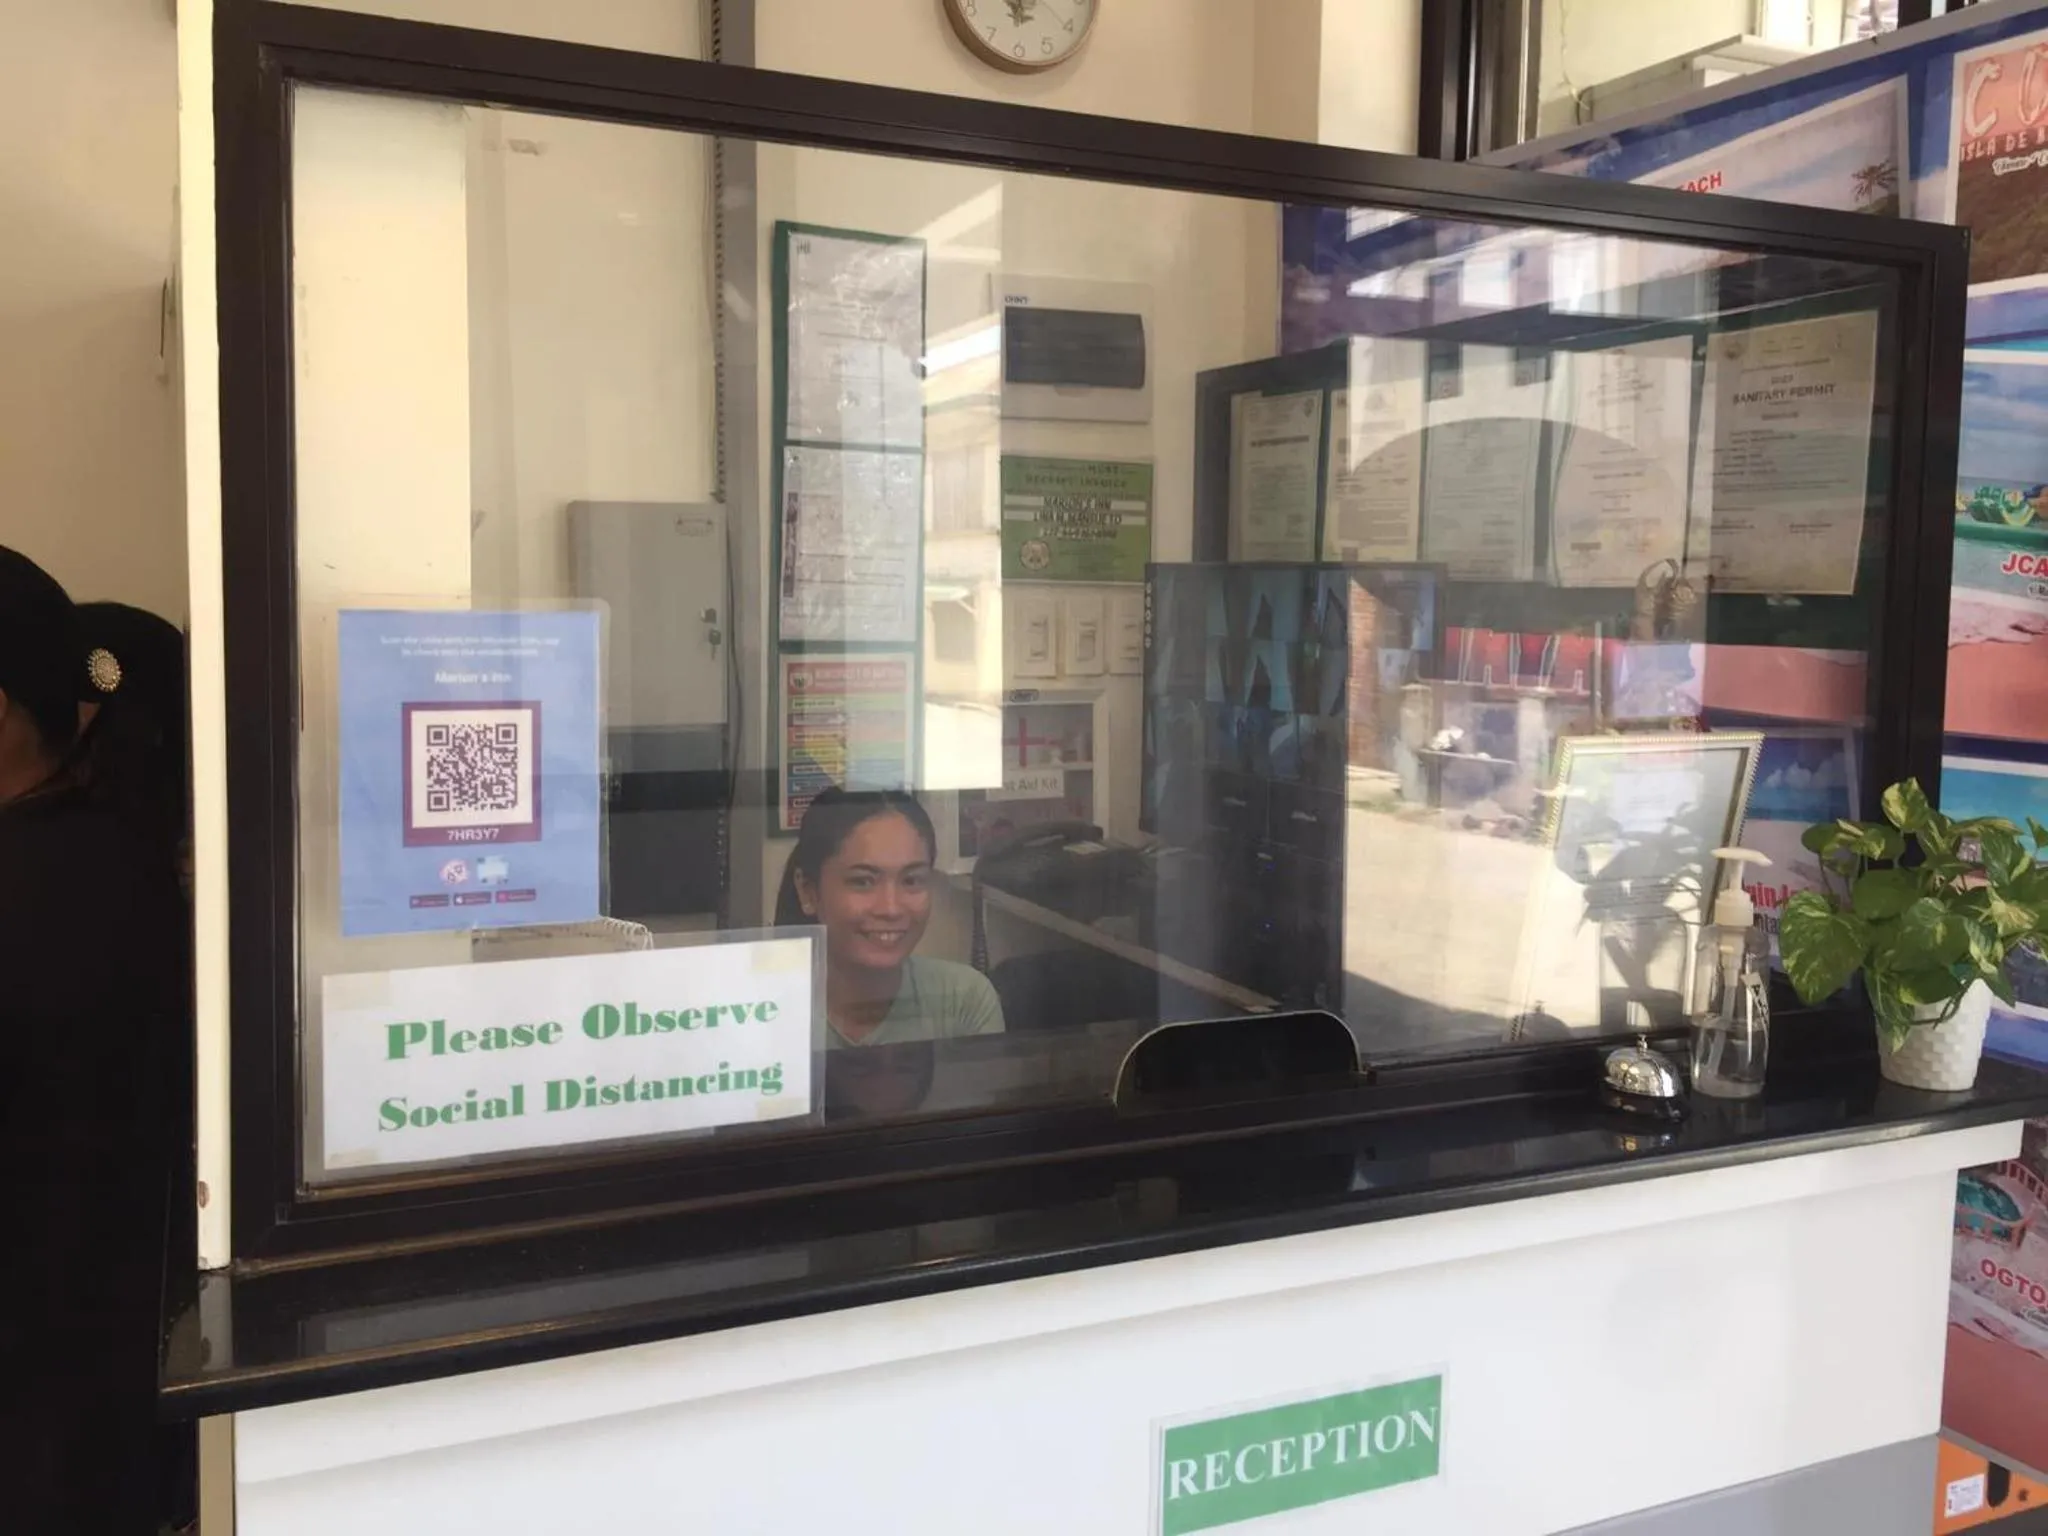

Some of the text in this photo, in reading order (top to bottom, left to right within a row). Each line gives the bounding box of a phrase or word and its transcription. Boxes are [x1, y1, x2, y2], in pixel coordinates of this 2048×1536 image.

[986, 26, 997, 42] 7
[1063, 19, 1074, 33] 4
[1014, 42, 1025, 57] 6
[1042, 37, 1053, 54] 5
[1733, 383, 1836, 405] SANITARY PERMIT
[447, 828, 500, 841] 7HR3Y7
[384, 998, 779, 1061] Please Observe
[378, 1061, 783, 1133] Social Distancing
[1168, 1406, 1438, 1500] RECEPTION
